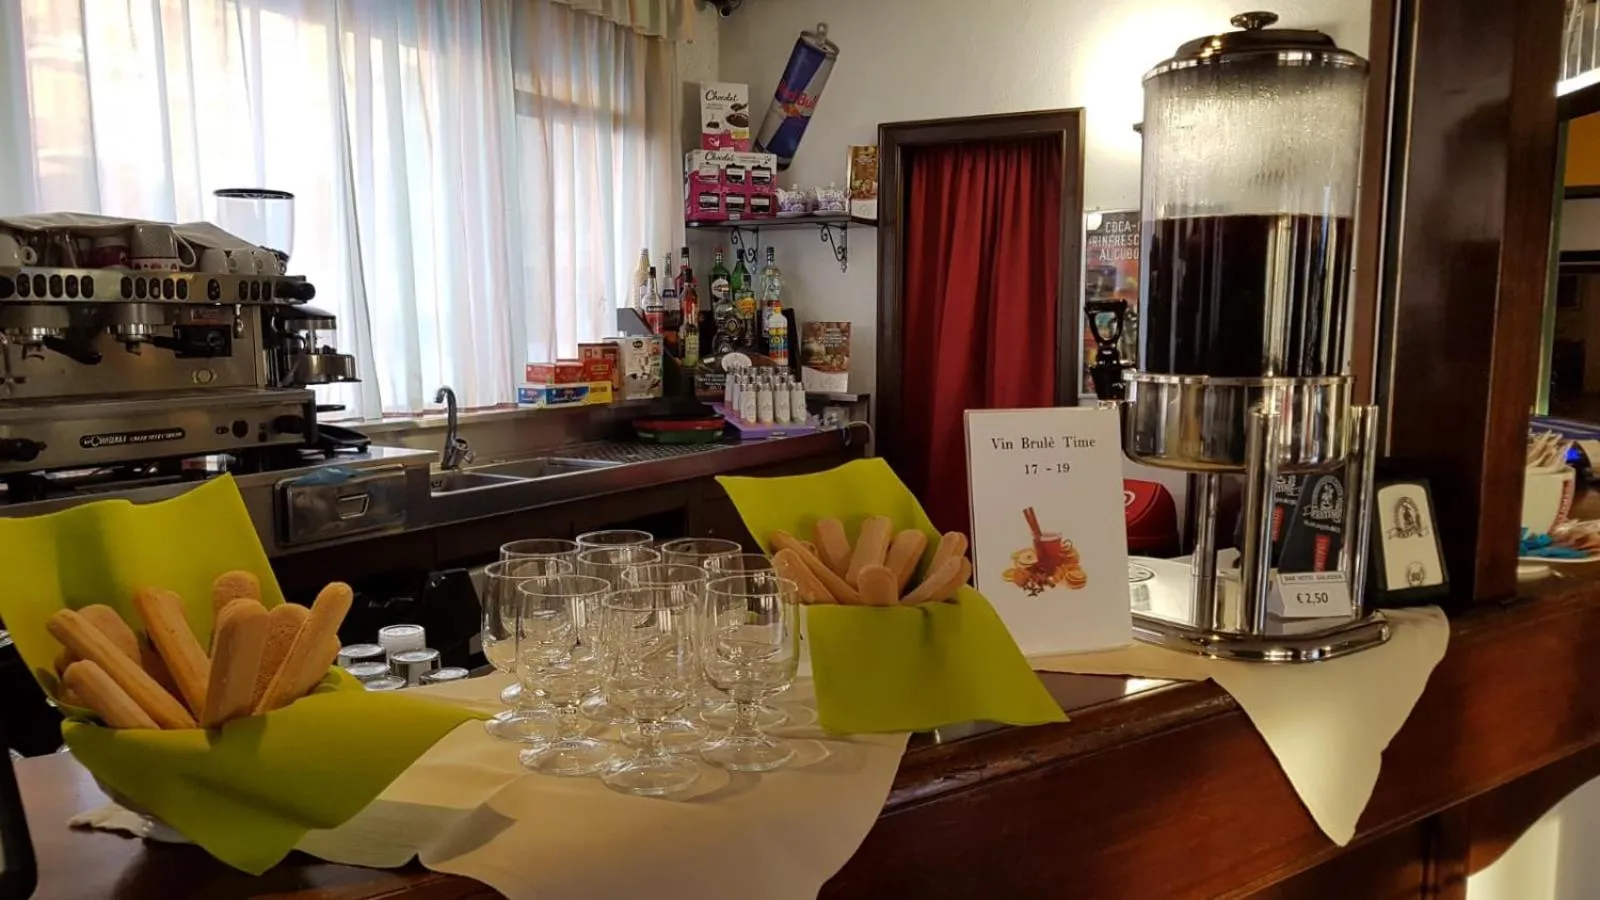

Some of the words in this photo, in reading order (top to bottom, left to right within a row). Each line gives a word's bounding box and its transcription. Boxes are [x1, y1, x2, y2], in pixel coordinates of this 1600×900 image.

[991, 437, 1014, 450] Vin
[1021, 436, 1056, 449] Brulè
[1062, 435, 1096, 448] Time
[1024, 463, 1038, 475] 17
[1057, 462, 1071, 473] 19
